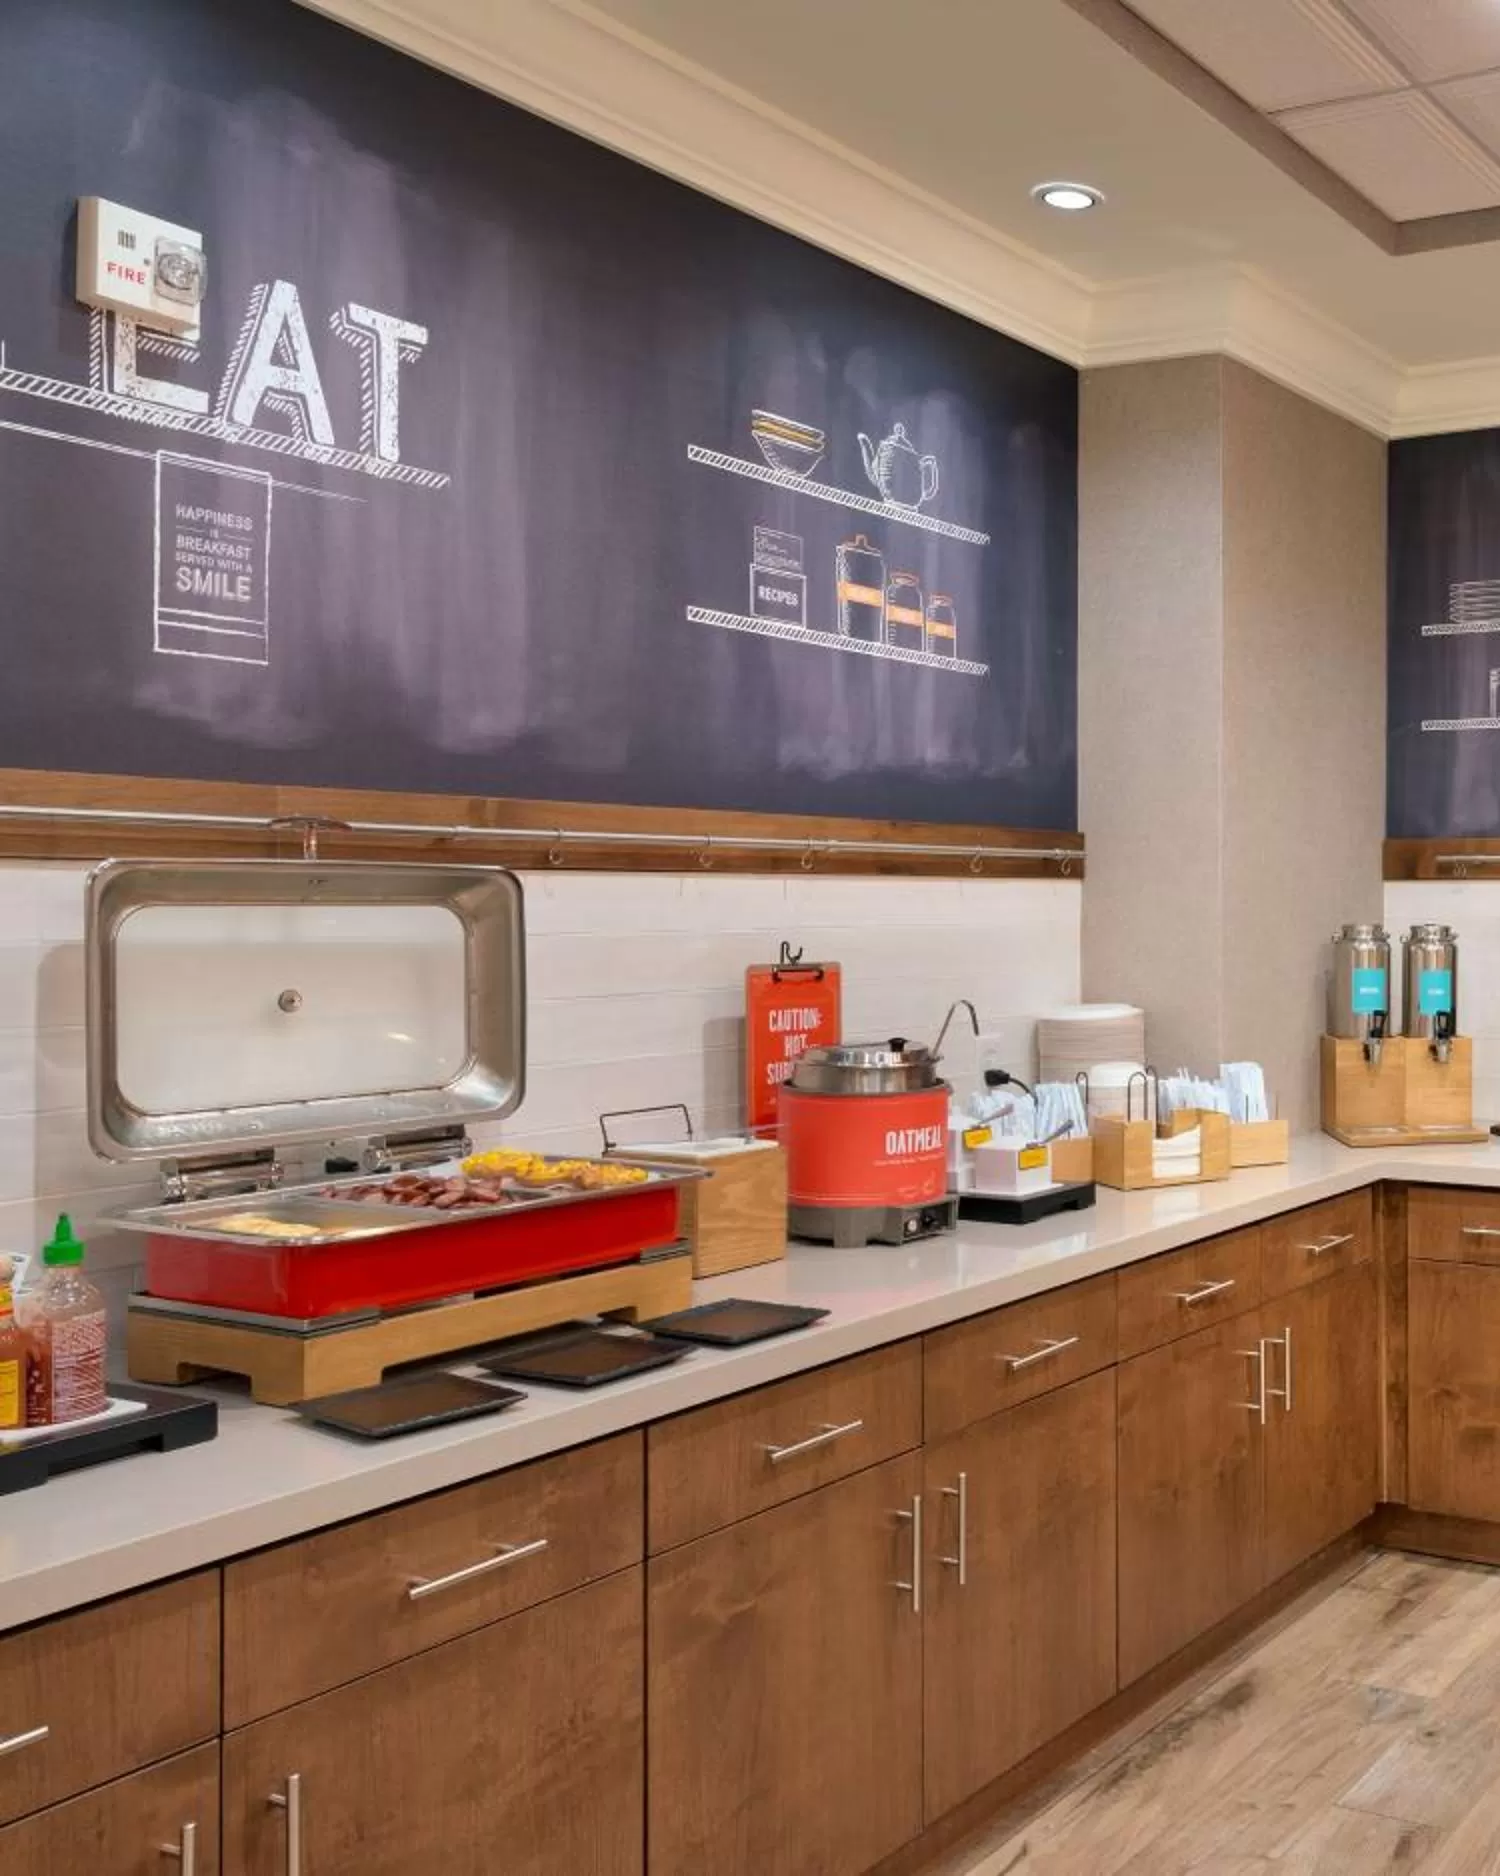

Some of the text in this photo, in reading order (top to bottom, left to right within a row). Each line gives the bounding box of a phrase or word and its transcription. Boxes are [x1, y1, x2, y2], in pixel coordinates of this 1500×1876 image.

[107, 262, 147, 285] FIRE
[176, 504, 253, 531] HAPPINESS
[176, 534, 253, 561] BREAKFAST
[217, 559, 243, 573] WITH
[245, 563, 253, 575] A
[176, 566, 253, 603] SMILE
[884, 1123, 943, 1156] OATMEAL
